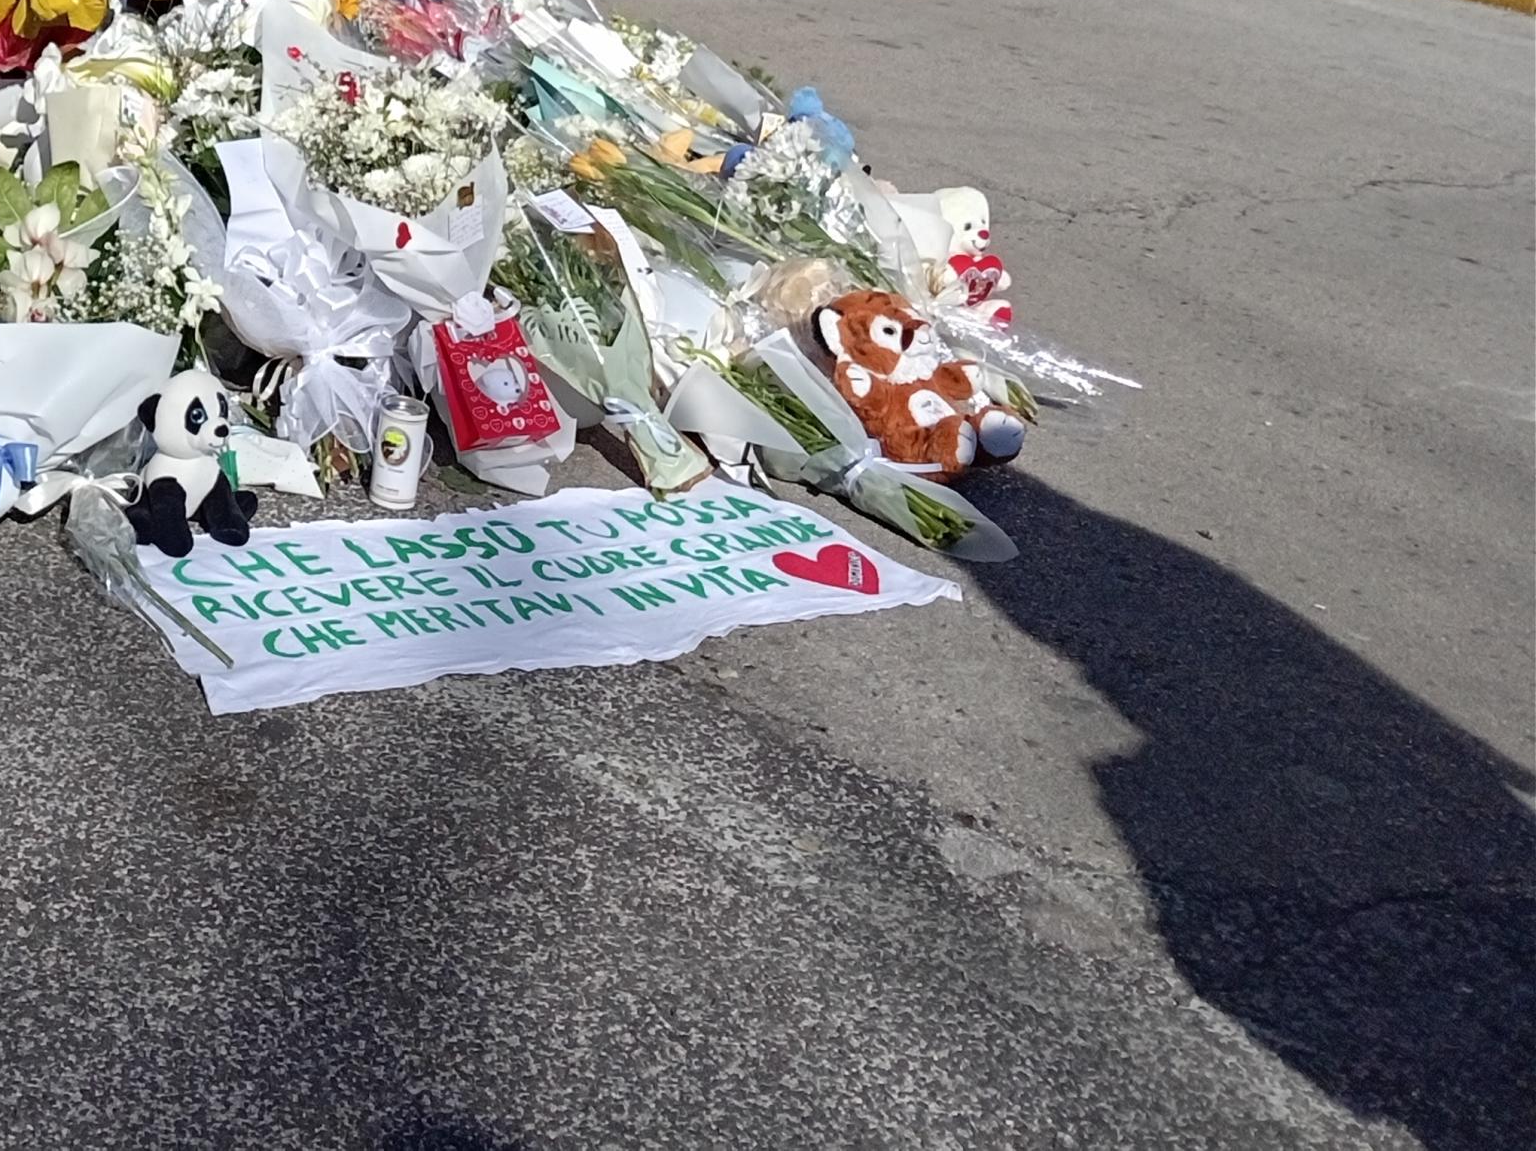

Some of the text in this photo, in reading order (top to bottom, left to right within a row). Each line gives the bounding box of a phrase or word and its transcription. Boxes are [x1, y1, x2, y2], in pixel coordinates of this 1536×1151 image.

[171, 541, 333, 587] CHE
[536, 519, 619, 544] TU
[613, 495, 771, 532] POSSA
[192, 516, 833, 624] RICEVERE IL CUORE GRANDE
[262, 619, 367, 658] CHE
[366, 591, 604, 639] MERITAVI
